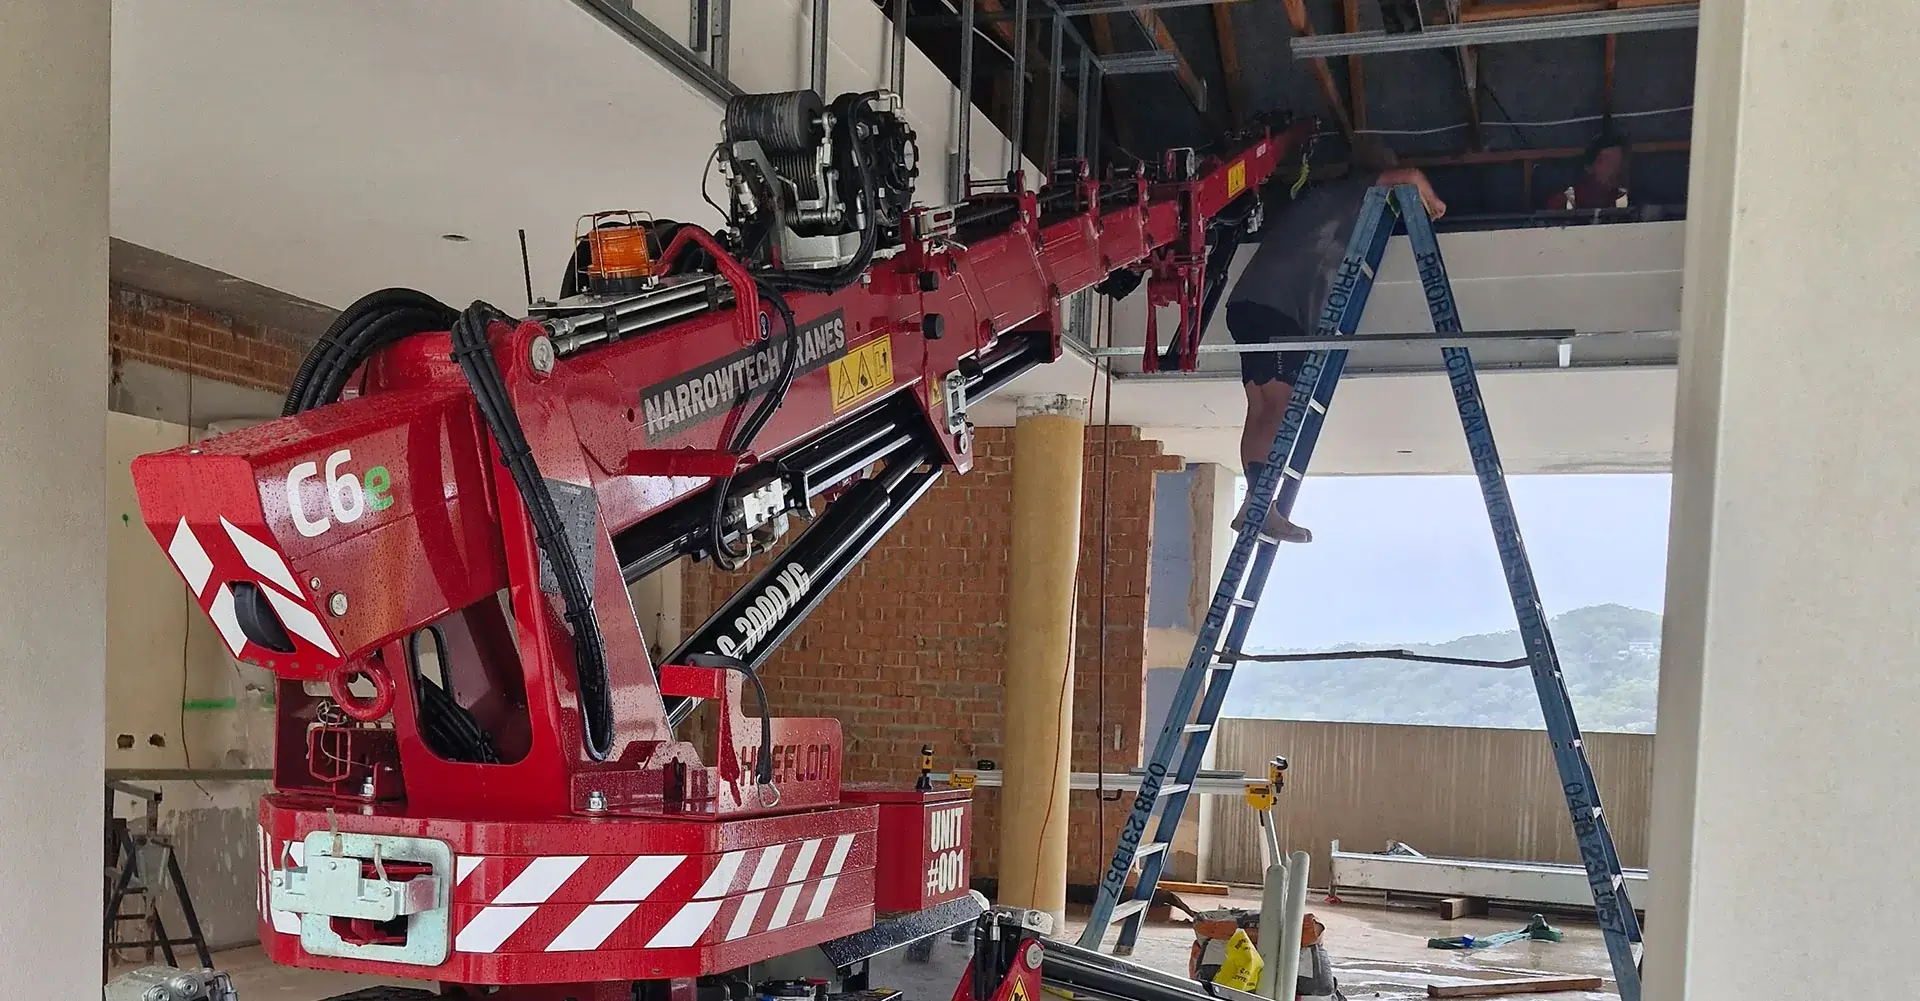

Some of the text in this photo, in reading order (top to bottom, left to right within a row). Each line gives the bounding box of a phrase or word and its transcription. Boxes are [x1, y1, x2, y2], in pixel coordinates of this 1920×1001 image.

[1321, 259, 1362, 326] PRIOR
[644, 350, 782, 436] NARROWTECH
[1275, 325, 1333, 446] EECTRICAL
[1416, 252, 1451, 317] PRIOR
[1436, 318, 1486, 438] EECTRICAL
[1470, 443, 1516, 545] SERVICES
[286, 449, 394, 537] C6e
[1236, 449, 1288, 549] SERVICES
[734, 562, 811, 653] 3000 KG
[740, 744, 831, 787] HEFLON
[927, 849, 964, 897] #001
[930, 807, 964, 852] UNIT
[1101, 761, 1167, 899] 0418 231 057
[1565, 781, 1626, 937] 0418 231 057
